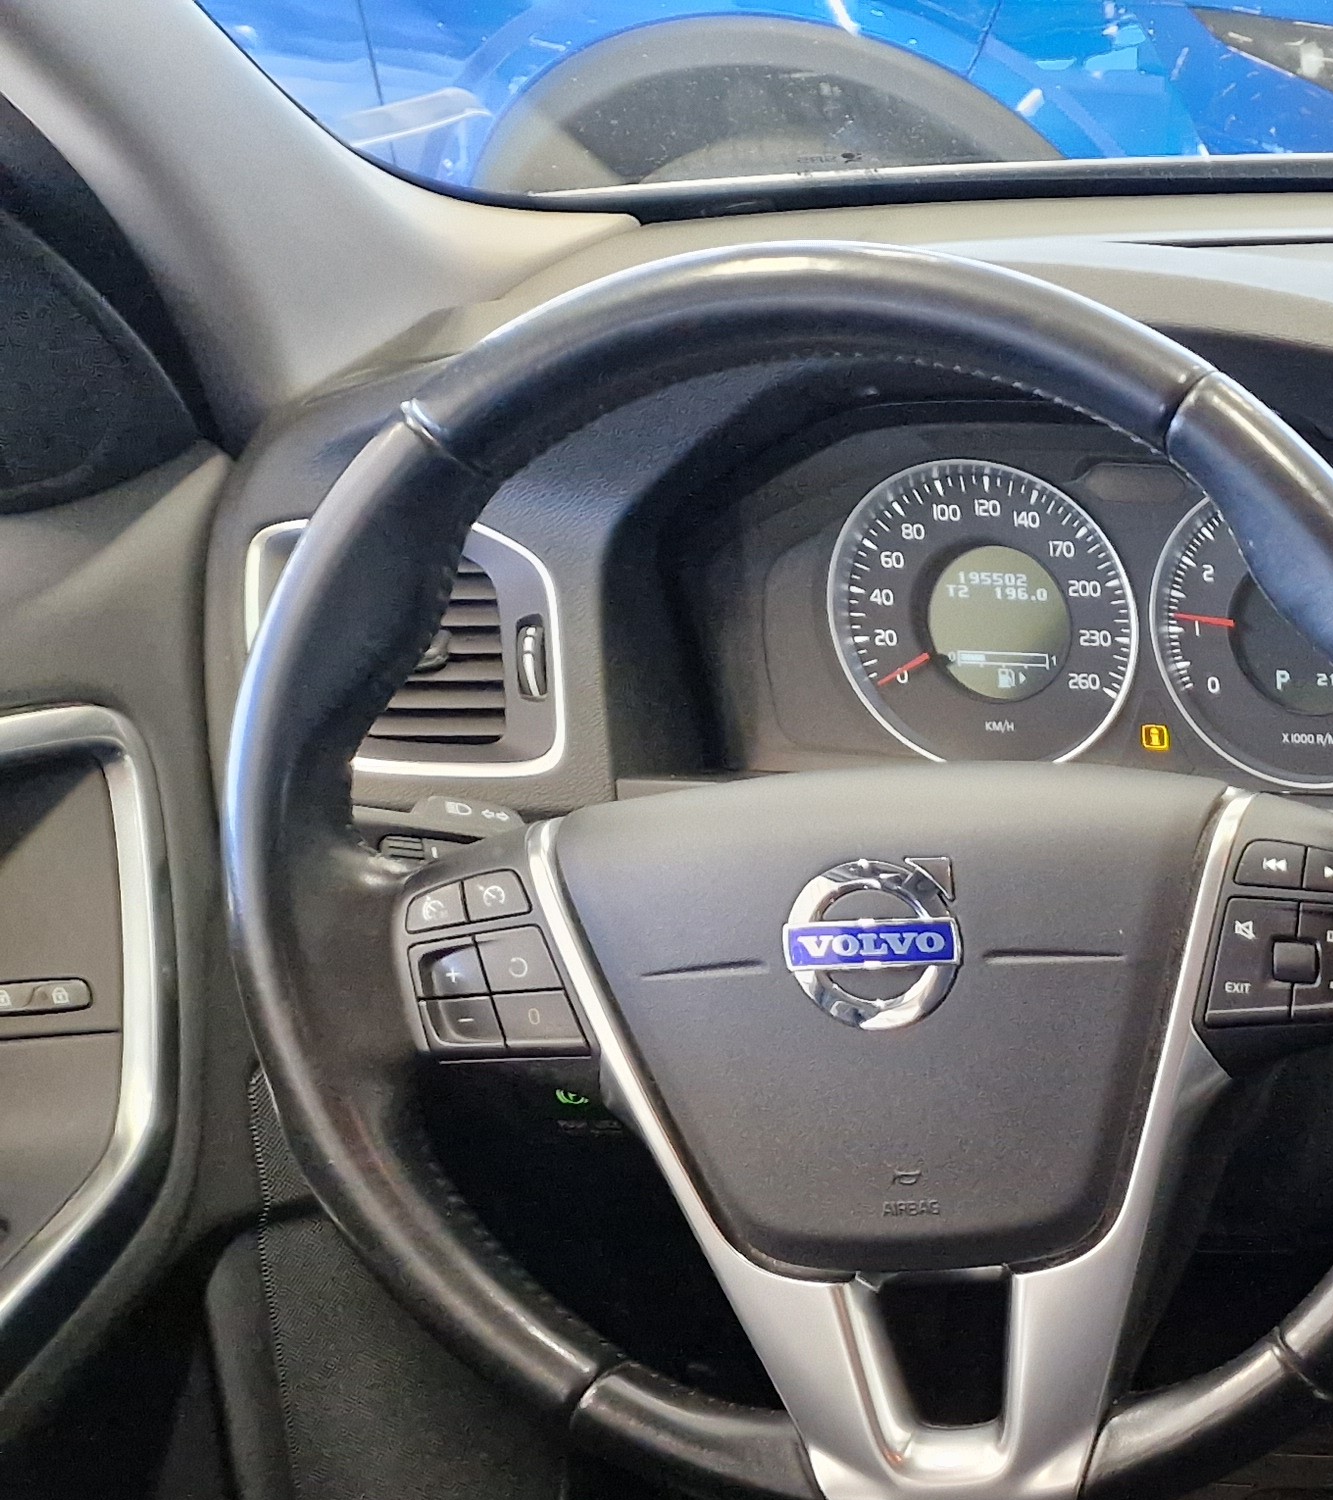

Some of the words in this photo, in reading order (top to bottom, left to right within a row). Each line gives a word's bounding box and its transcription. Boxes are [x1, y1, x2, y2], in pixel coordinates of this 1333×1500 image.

[932, 504, 961, 522] 100
[974, 500, 1001, 517] 120
[1013, 511, 1040, 528] 140
[901, 524, 925, 540] 80
[1048, 541, 1075, 558] 170
[880, 552, 904, 568] 60
[958, 571, 1028, 587] 195502
[1202, 564, 1215, 582] 2
[870, 589, 894, 606] 40
[946, 584, 970, 598] T2
[994, 586, 1048, 602] 196.0
[1068, 580, 1101, 598] 200
[874, 630, 897, 646] 20
[1079, 630, 1112, 647] 230
[1068, 673, 1100, 690] 260
[1207, 676, 1221, 694] 0
[1275, 669, 1290, 691] P
[985, 720, 1015, 732] KM/H
[797, 932, 946, 958] VOLVO
[1225, 981, 1252, 994] EXIT
